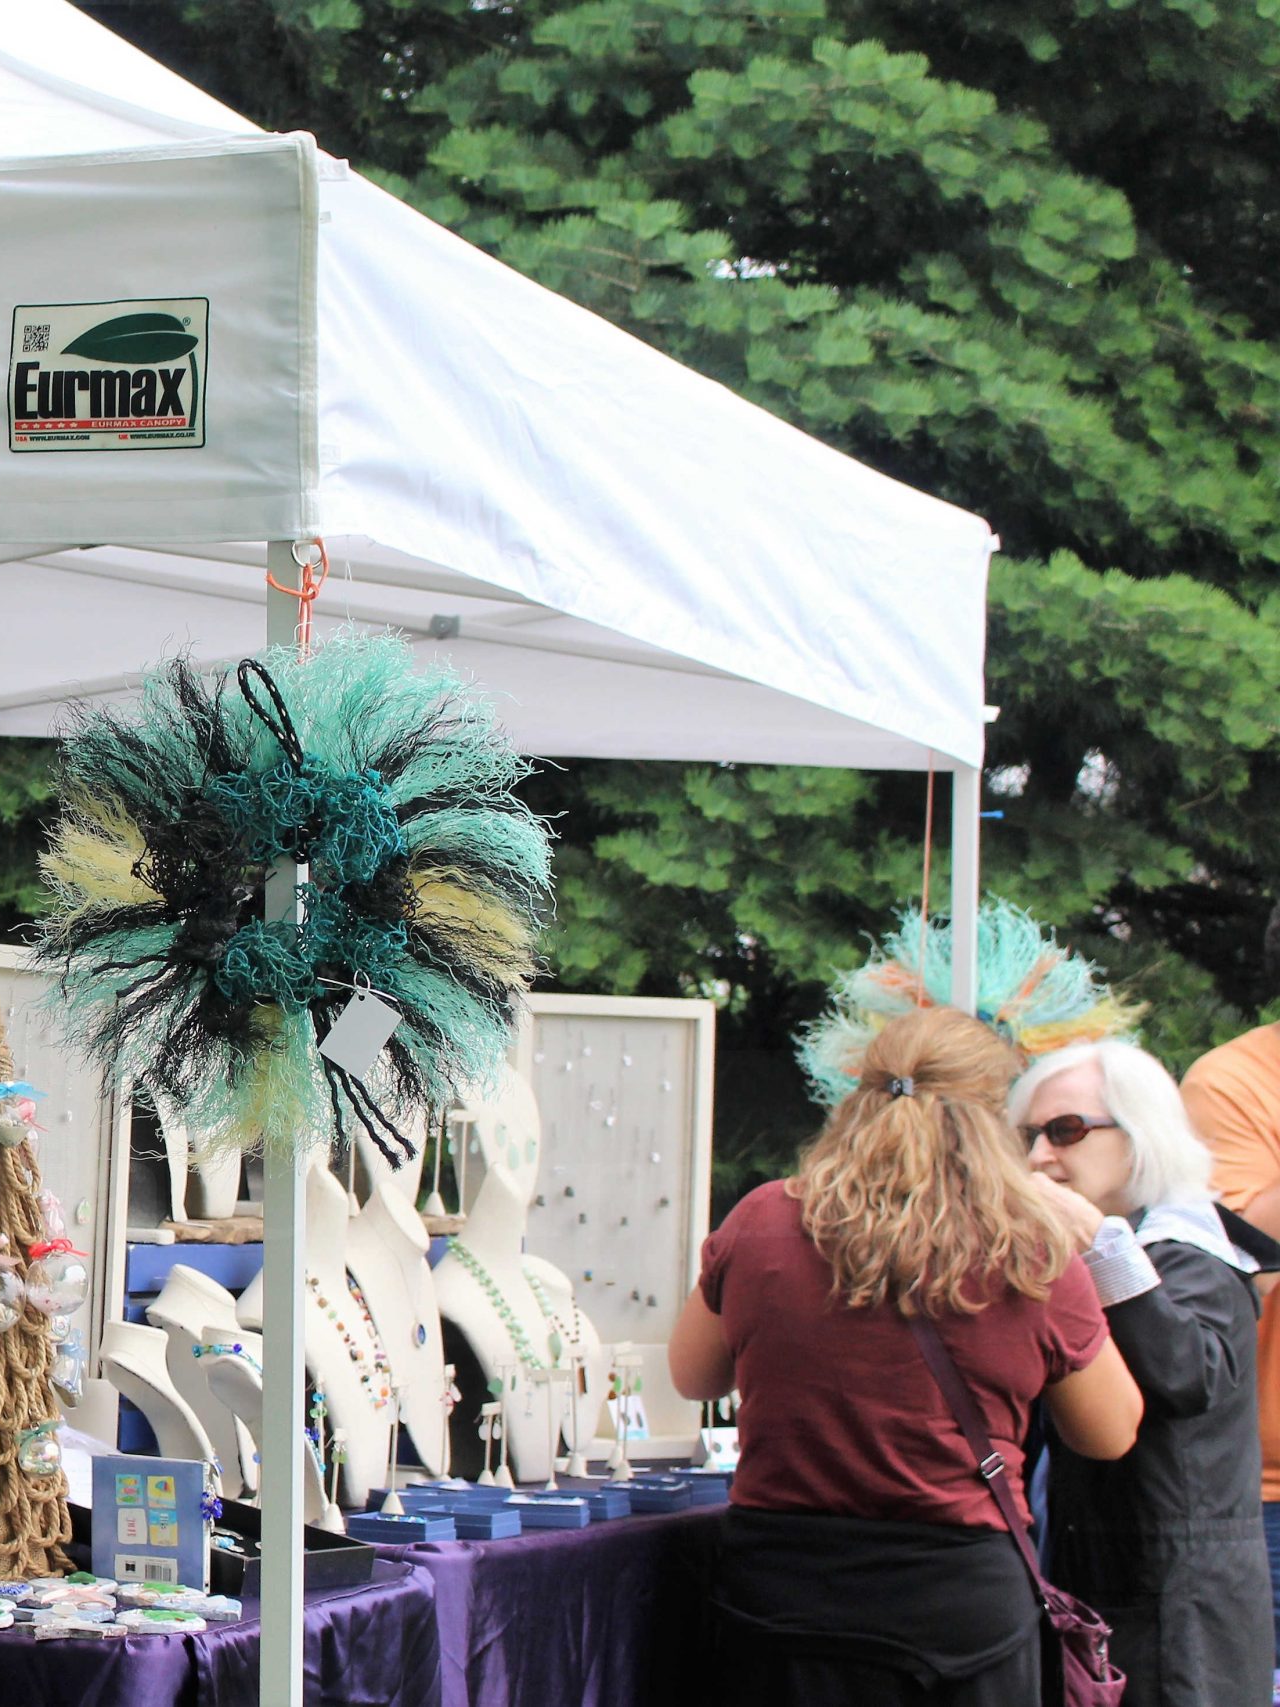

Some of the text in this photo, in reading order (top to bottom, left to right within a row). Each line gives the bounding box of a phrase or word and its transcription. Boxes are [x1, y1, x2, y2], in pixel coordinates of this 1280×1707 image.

[15, 361, 187, 419] Eurmax
[91, 419, 182, 428] EURMAX CANOPY
